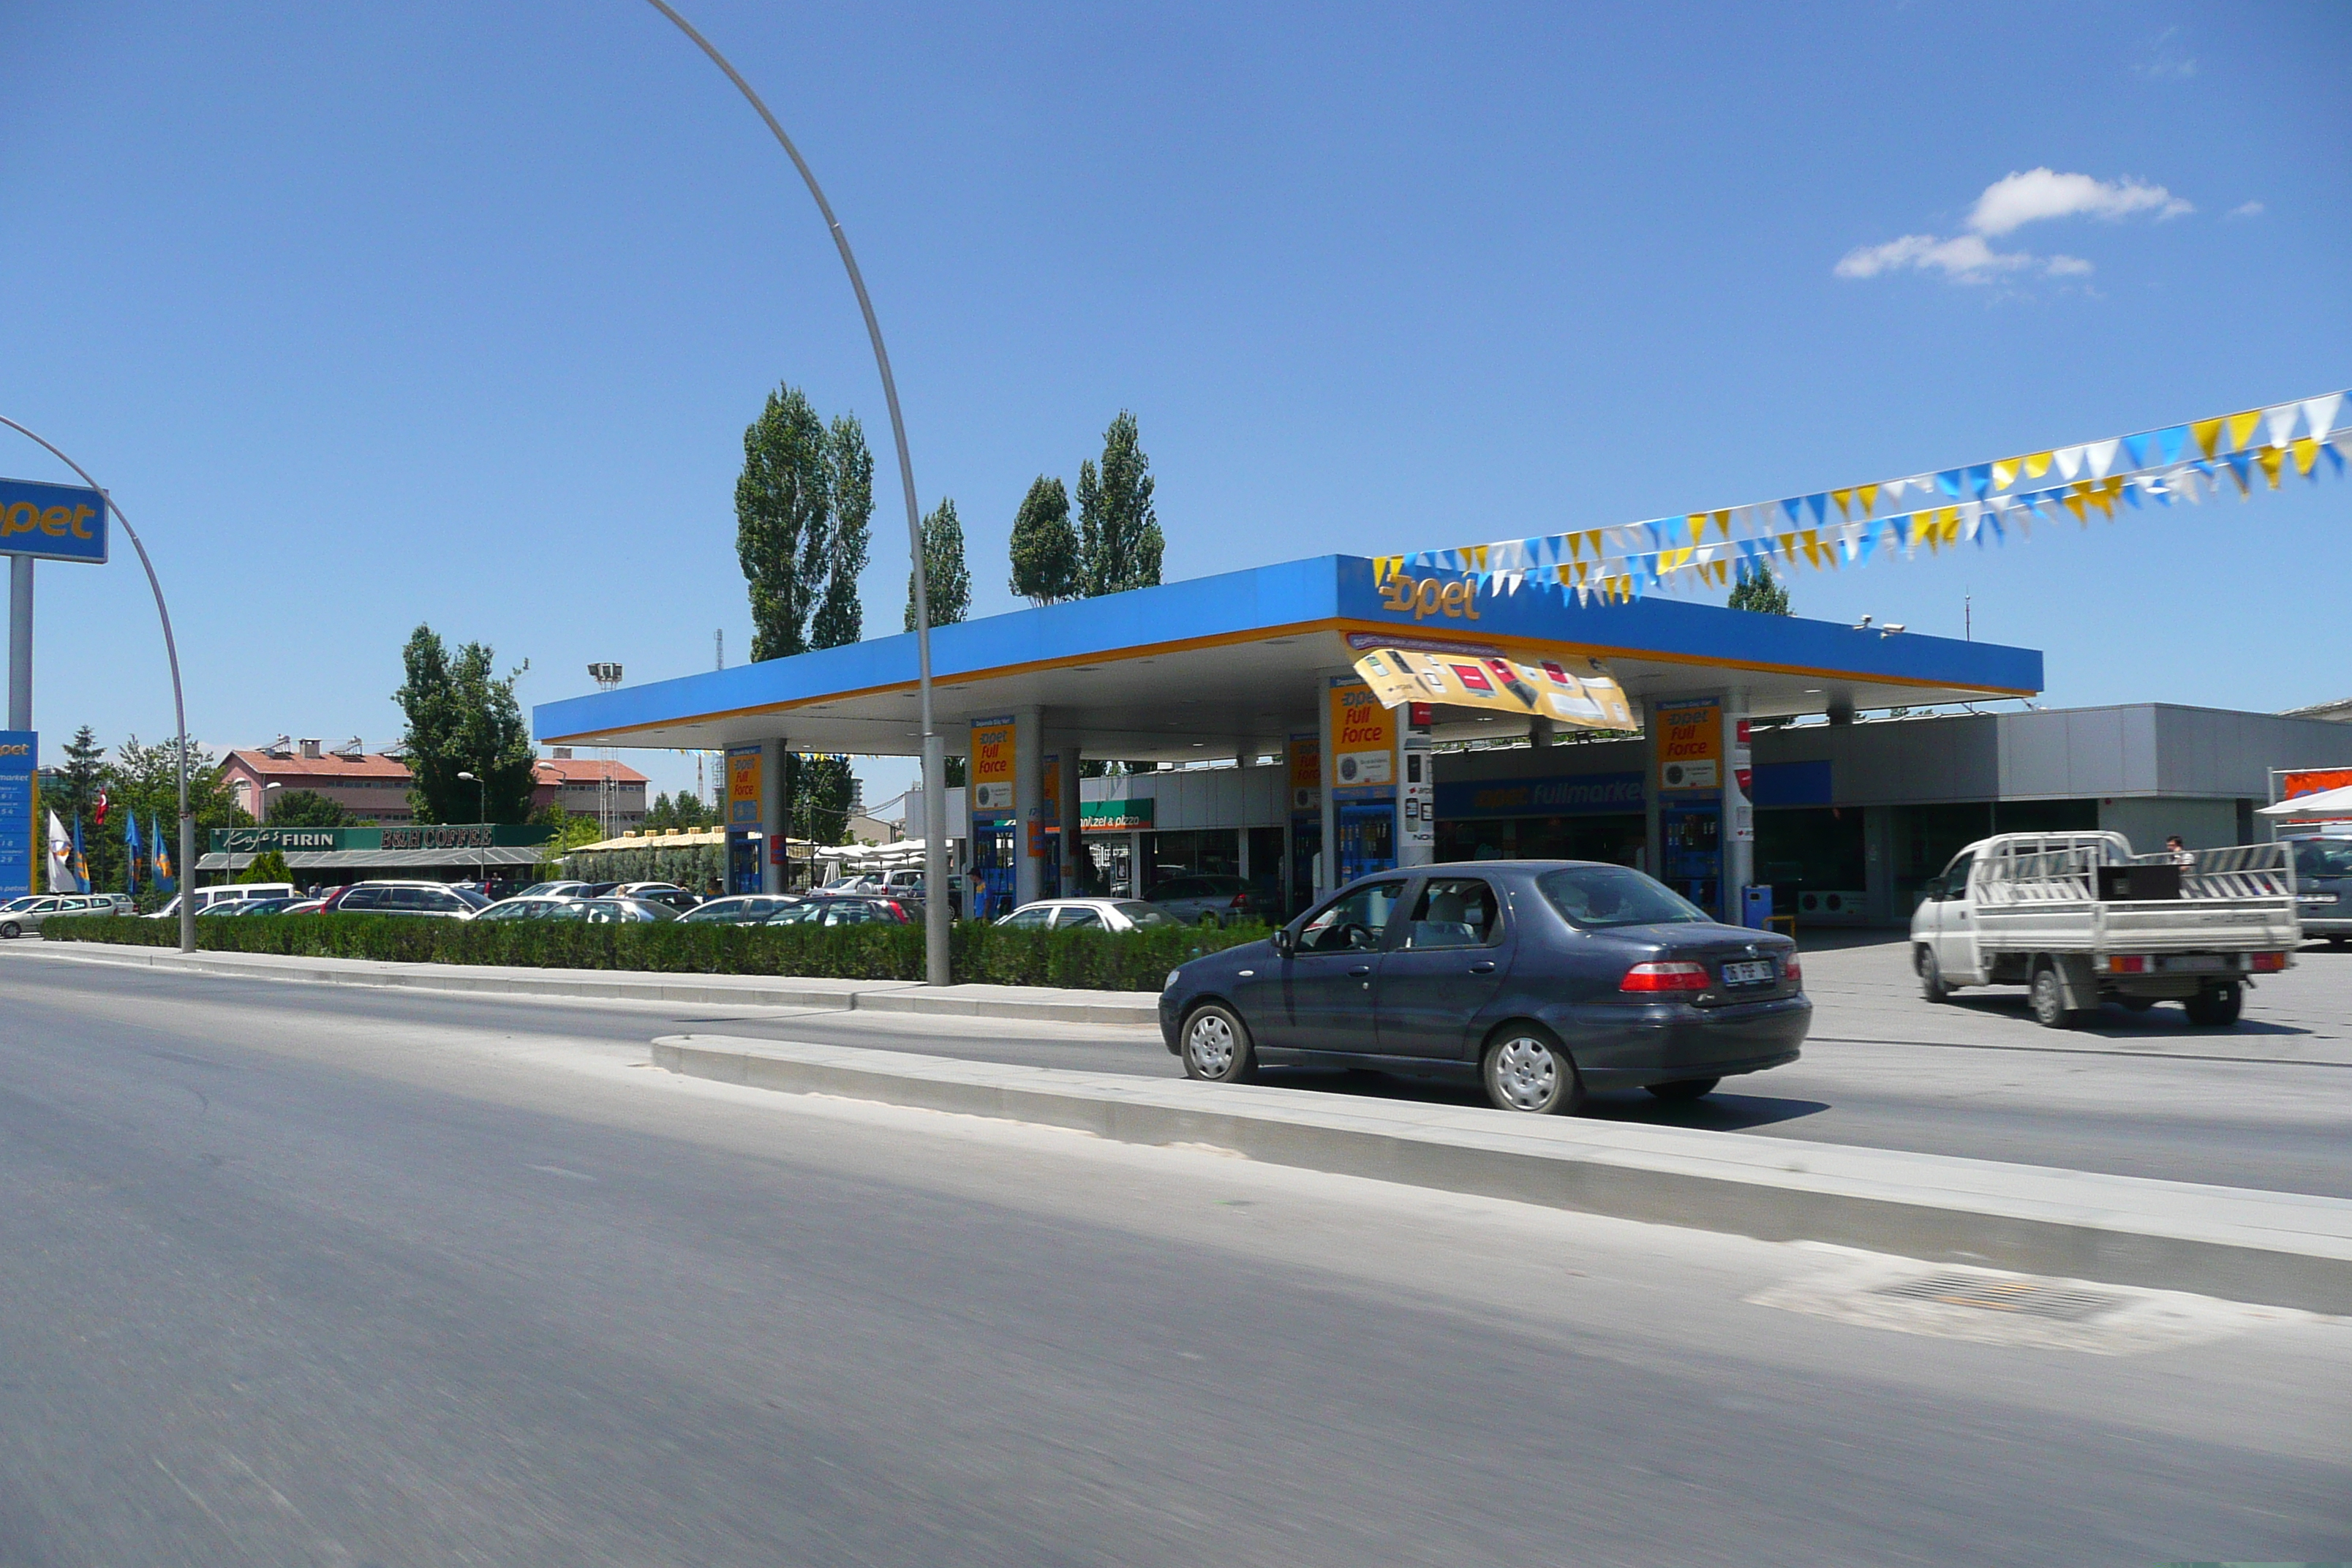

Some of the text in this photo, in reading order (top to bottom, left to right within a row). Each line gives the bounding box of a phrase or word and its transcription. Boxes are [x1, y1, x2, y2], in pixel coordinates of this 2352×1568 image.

[1341, 690, 1376, 708] ope
[1346, 706, 1371, 725] full
[1341, 725, 1384, 745] force
[1670, 725, 1697, 741] full
[0, 743, 29, 756] pet
[981, 743, 1000, 759] full
[1667, 742, 1708, 756] force
[979, 759, 1008, 774] force
[734, 784, 755, 796] force
[282, 834, 333, 846] FIRIN
[380, 826, 493, 848] B&H COFFEE
